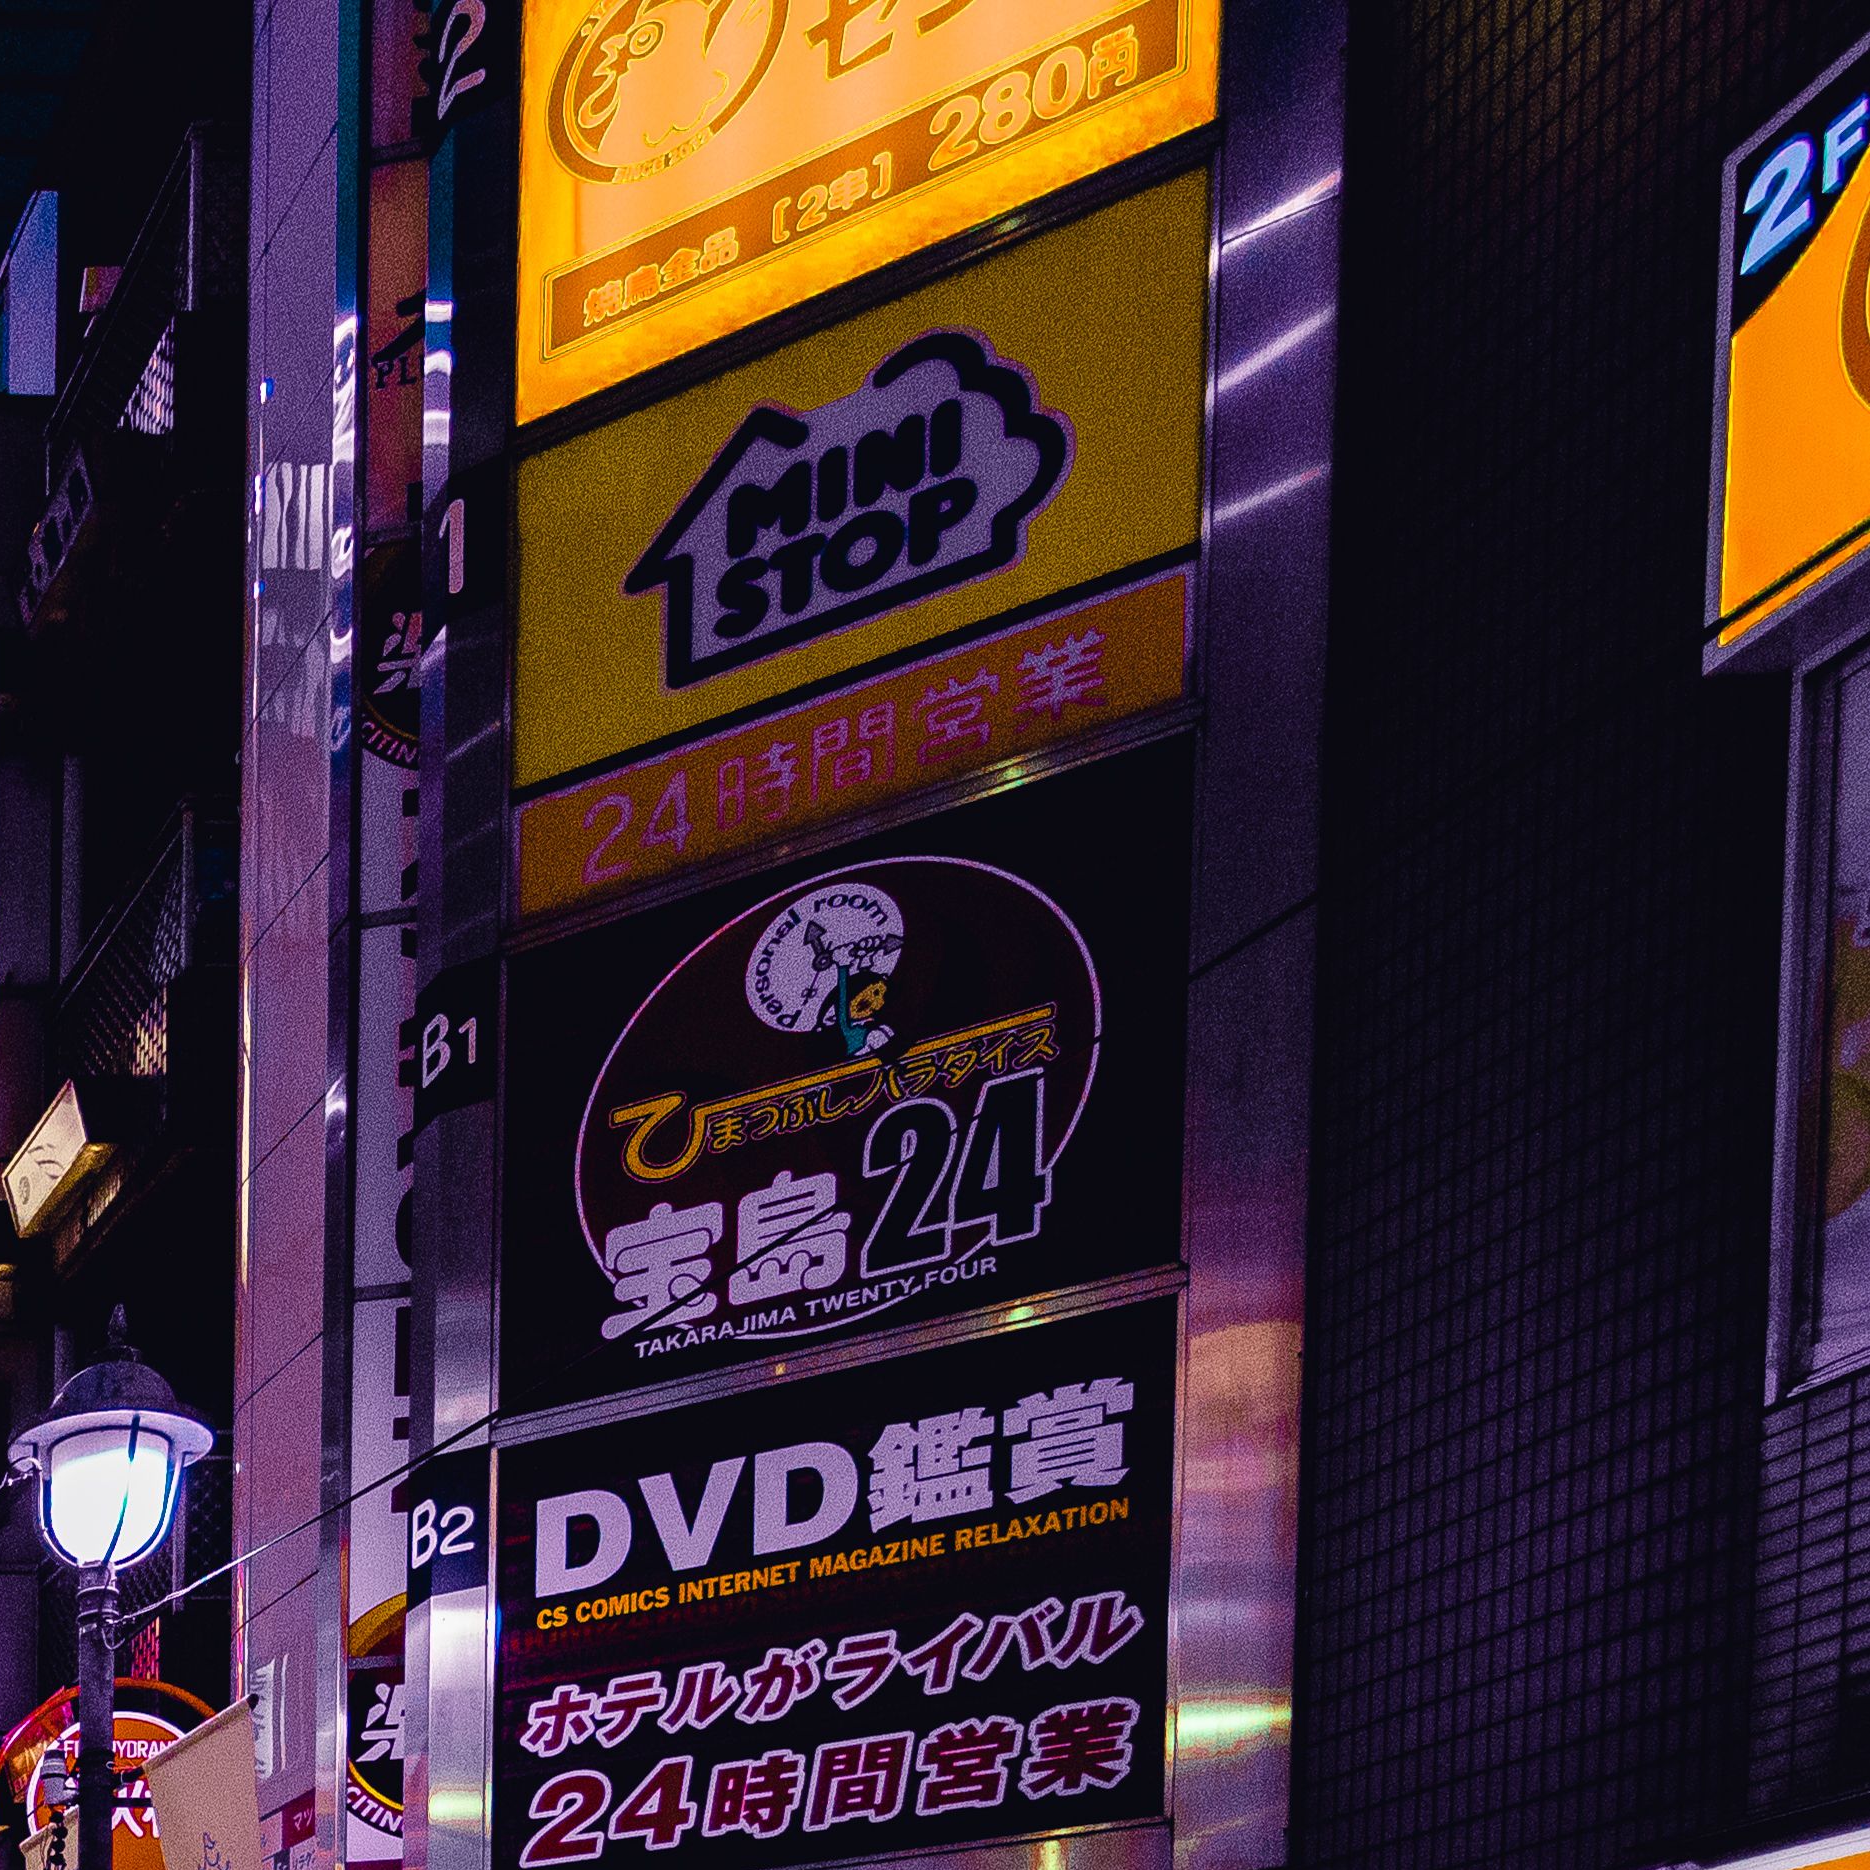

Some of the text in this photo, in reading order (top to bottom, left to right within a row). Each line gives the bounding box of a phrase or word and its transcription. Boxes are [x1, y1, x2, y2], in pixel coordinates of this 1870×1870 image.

[580, 226, 741, 327] 焼鳥全品
[927, 22, 1138, 171] 280円
[1740, 93, 1870, 275] 2F
[712, 476, 980, 640] STOP
[726, 398, 964, 560] MINI
[581, 626, 1108, 886] 24時間営業
[810, 891, 892, 927] room
[422, 1012, 477, 1089] B1
[611, 1002, 1060, 1183] ひまつぶしパラダイス
[634, 1256, 997, 1360] TAKARAJIMA TWENTY FOUR
[410, 1499, 475, 1569] B2
[535, 1377, 1136, 1600] DVD鑑賞
[536, 1497, 1129, 1630] CS COMICS INTERNET MAGAZINE RELAXATION
[520, 1588, 1144, 1758] ホテルがライバル
[520, 1697, 1139, 1869] 24時間営業
